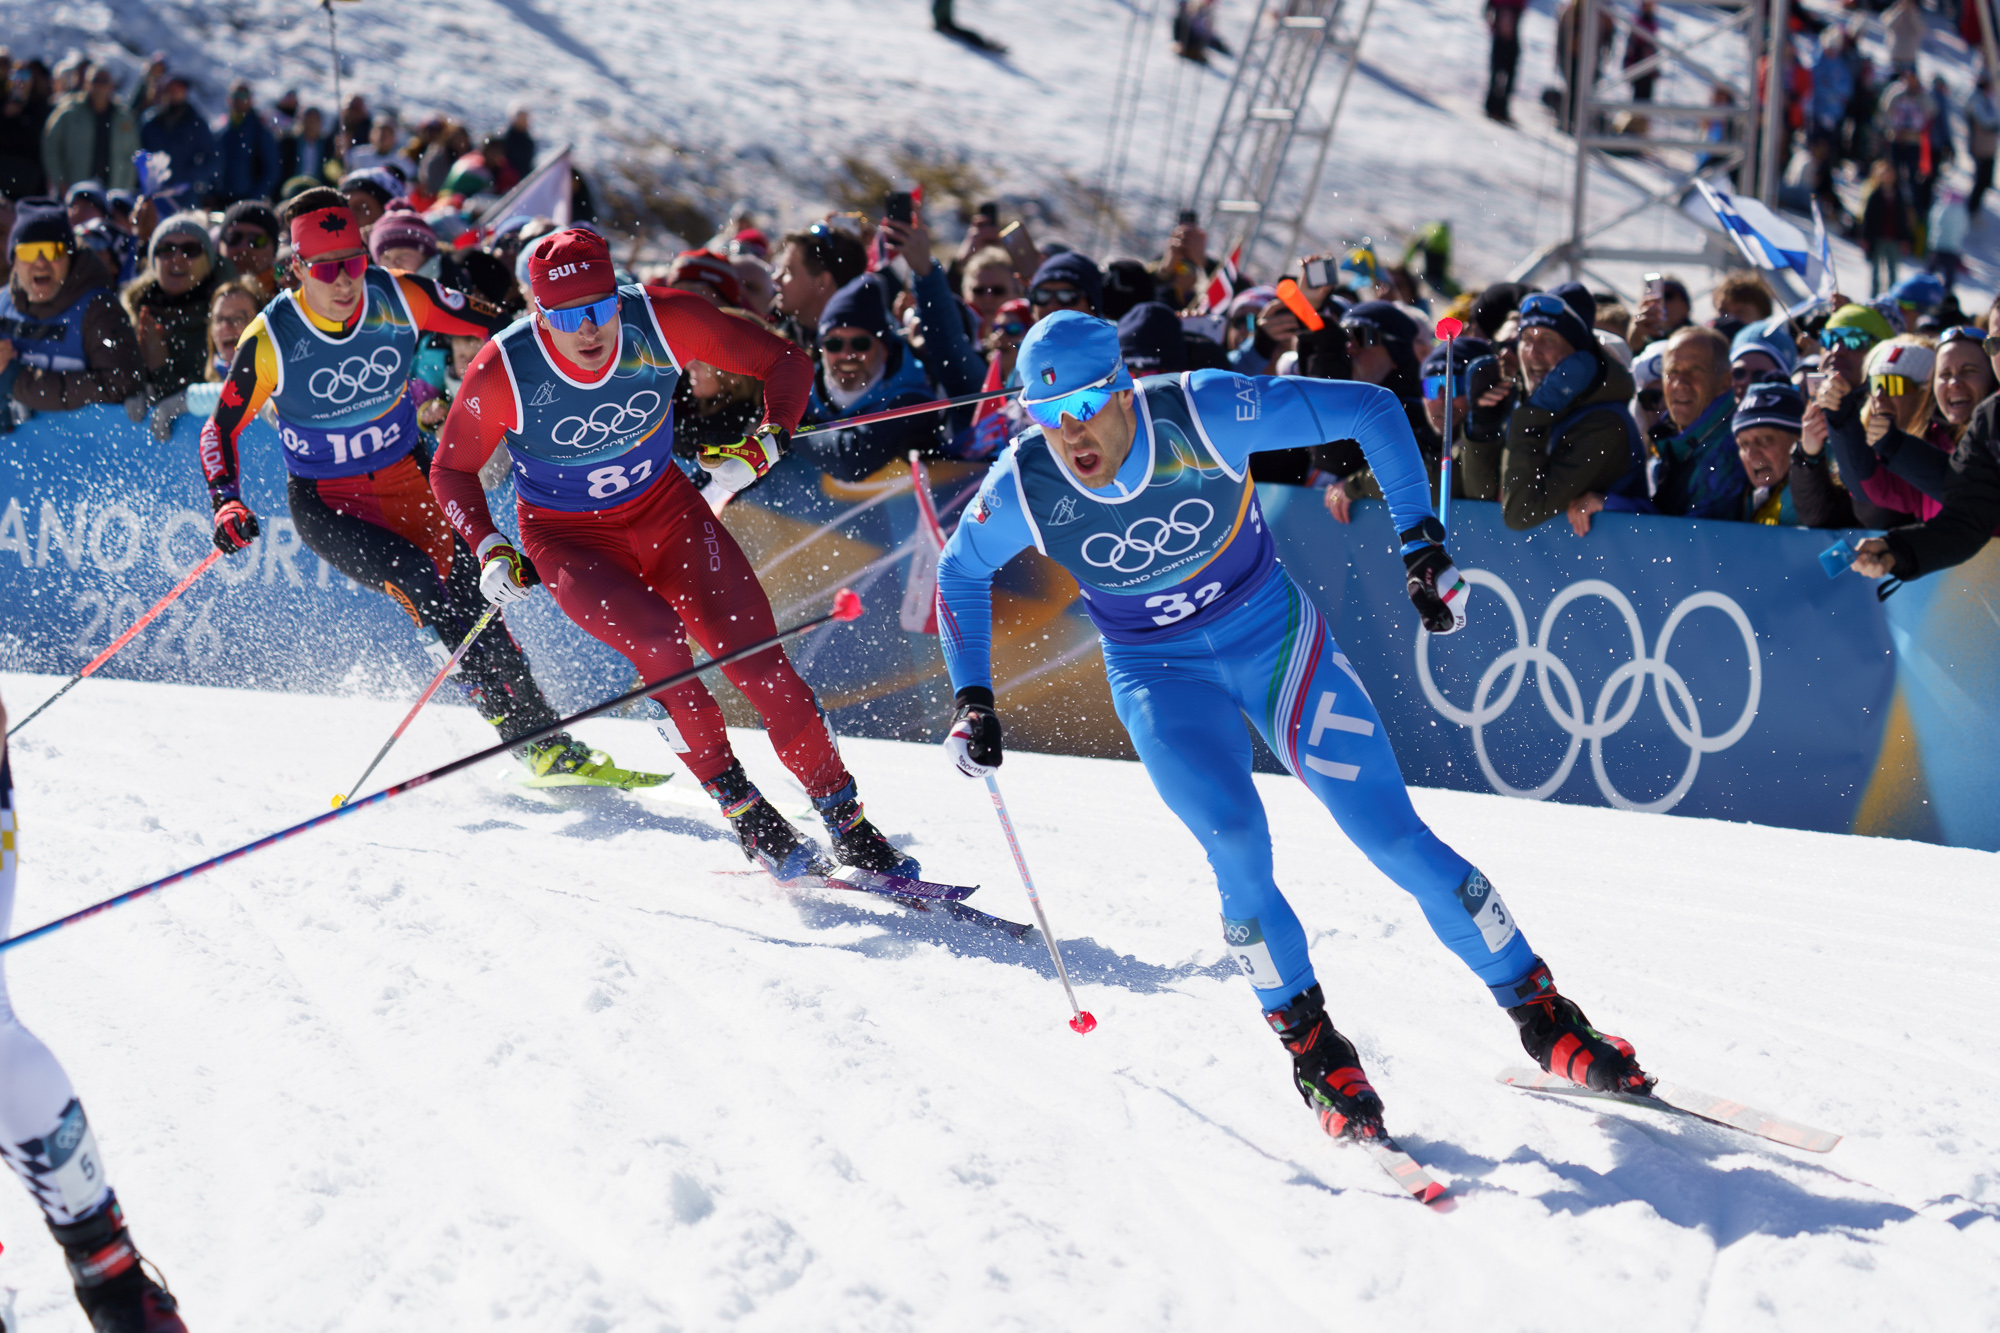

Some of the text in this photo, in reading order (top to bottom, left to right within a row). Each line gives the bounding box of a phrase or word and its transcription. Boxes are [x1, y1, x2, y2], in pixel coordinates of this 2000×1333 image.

[311, 393, 392, 420] MILANO CORTINA
[726, 447, 757, 459] LEKI
[1099, 525, 1232, 588] MILANO CORTINA 2026
[657, 726, 669, 743] 8
[1492, 902, 1506, 925] 3
[1239, 954, 1255, 975] 3
[79, 1153, 96, 1181] 5
